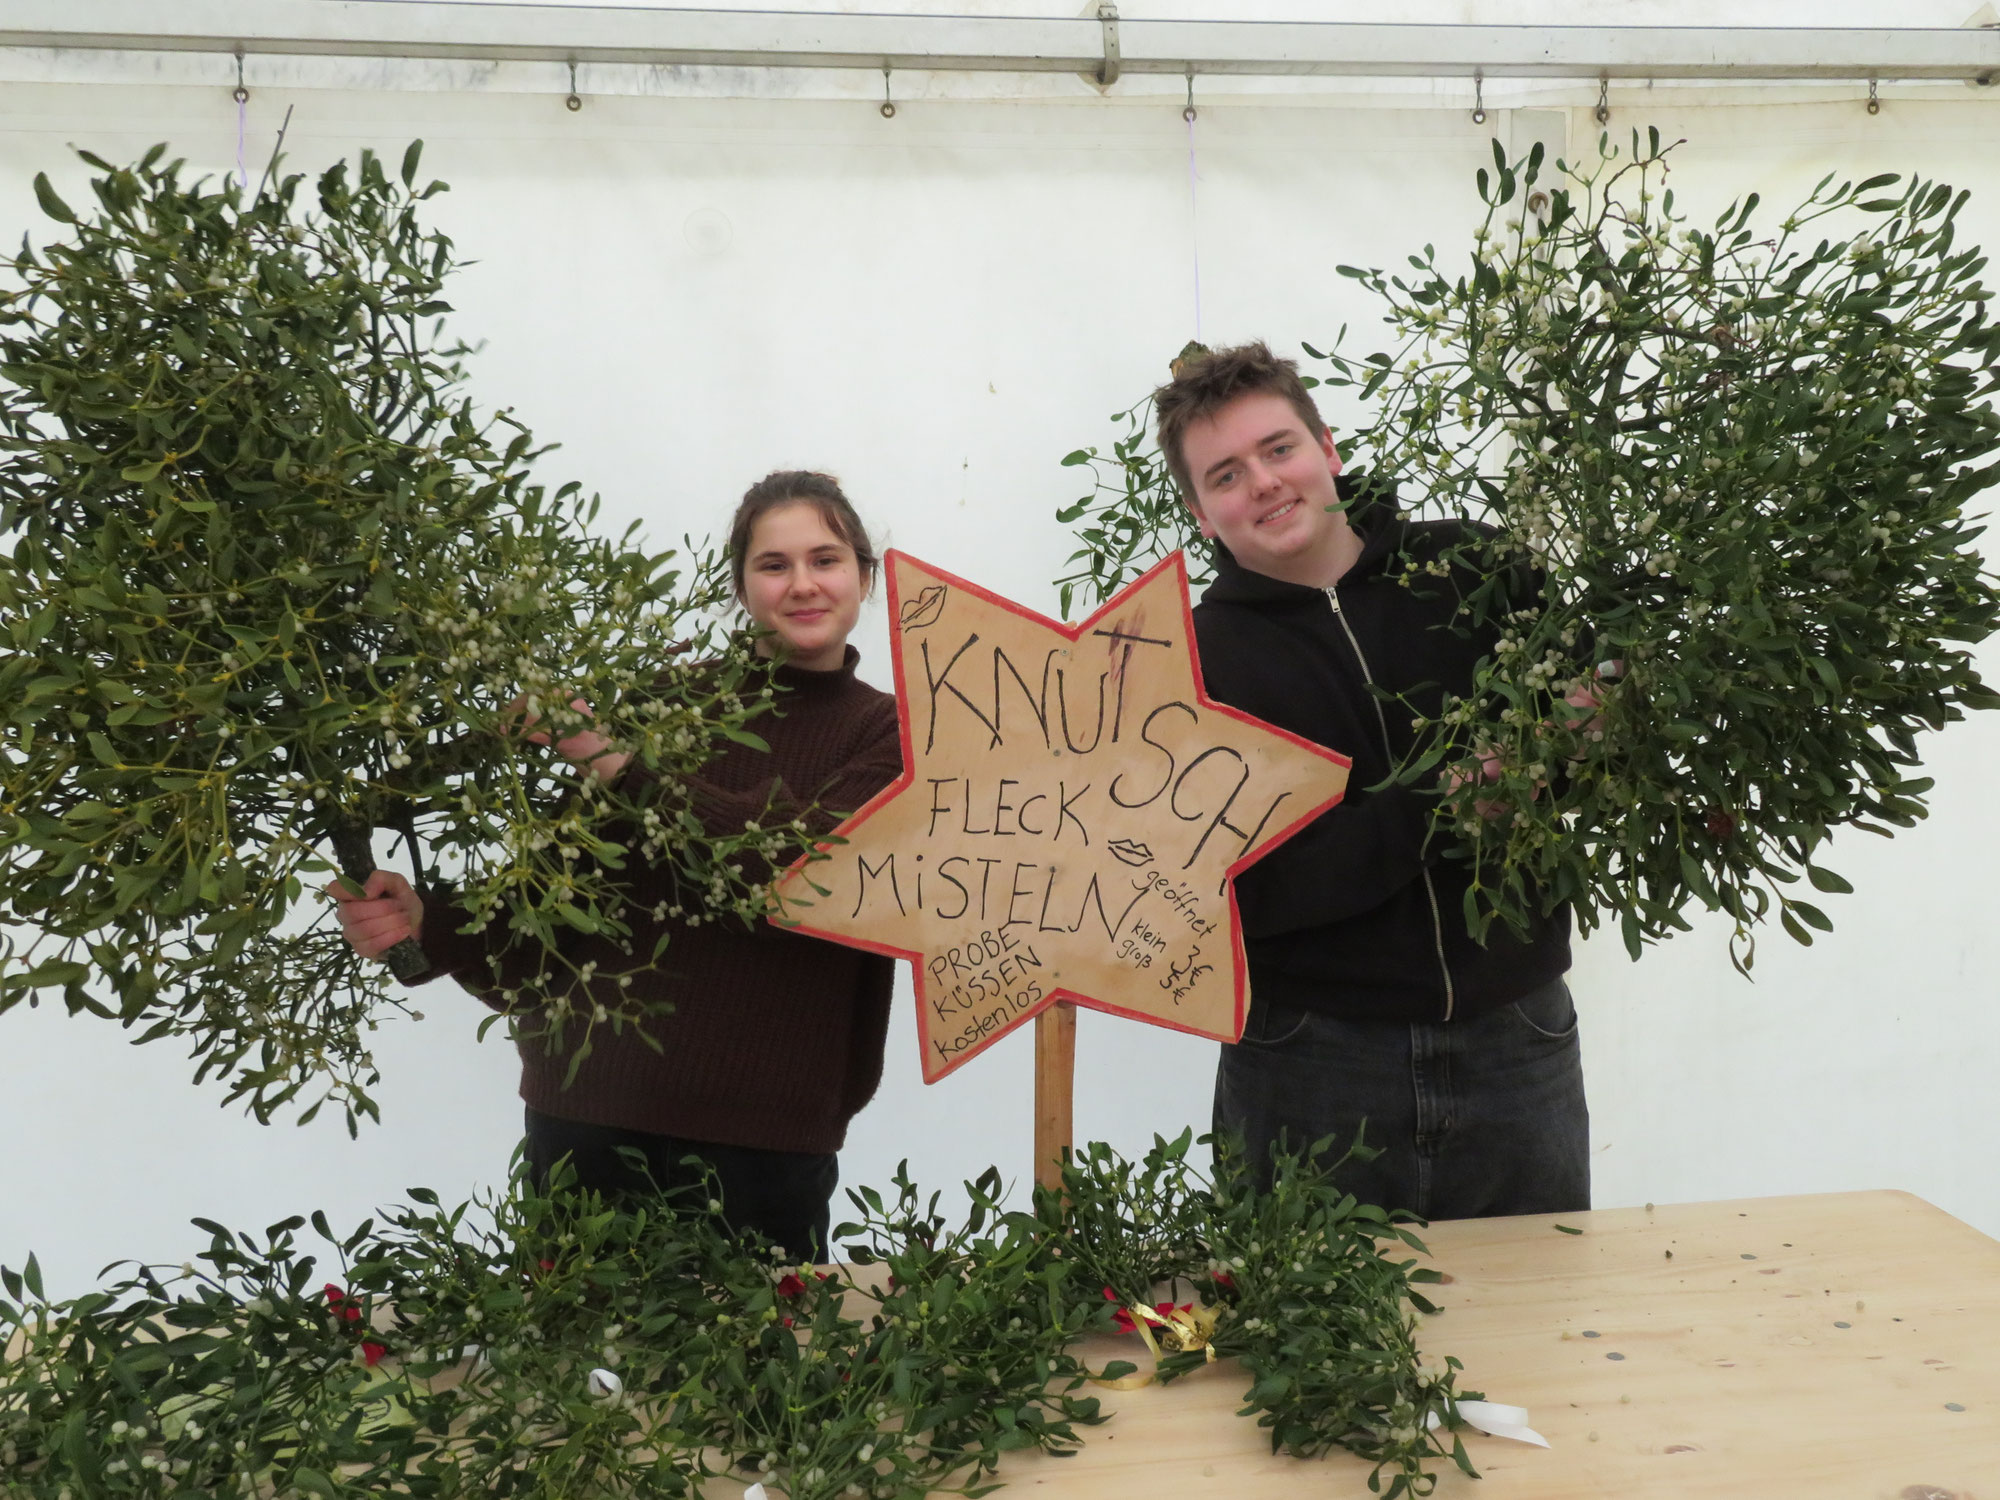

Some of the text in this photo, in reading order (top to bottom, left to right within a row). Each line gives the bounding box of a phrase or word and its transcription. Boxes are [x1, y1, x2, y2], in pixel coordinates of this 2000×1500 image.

[926, 777, 1092, 846] FLECK
[1130, 918, 1167, 953] klein
[1131, 870, 1218, 939] geöffnet
[927, 927, 1021, 986] PROBE
[932, 945, 1042, 1022] KÜSSEN
[1116, 939, 1152, 969] groß
